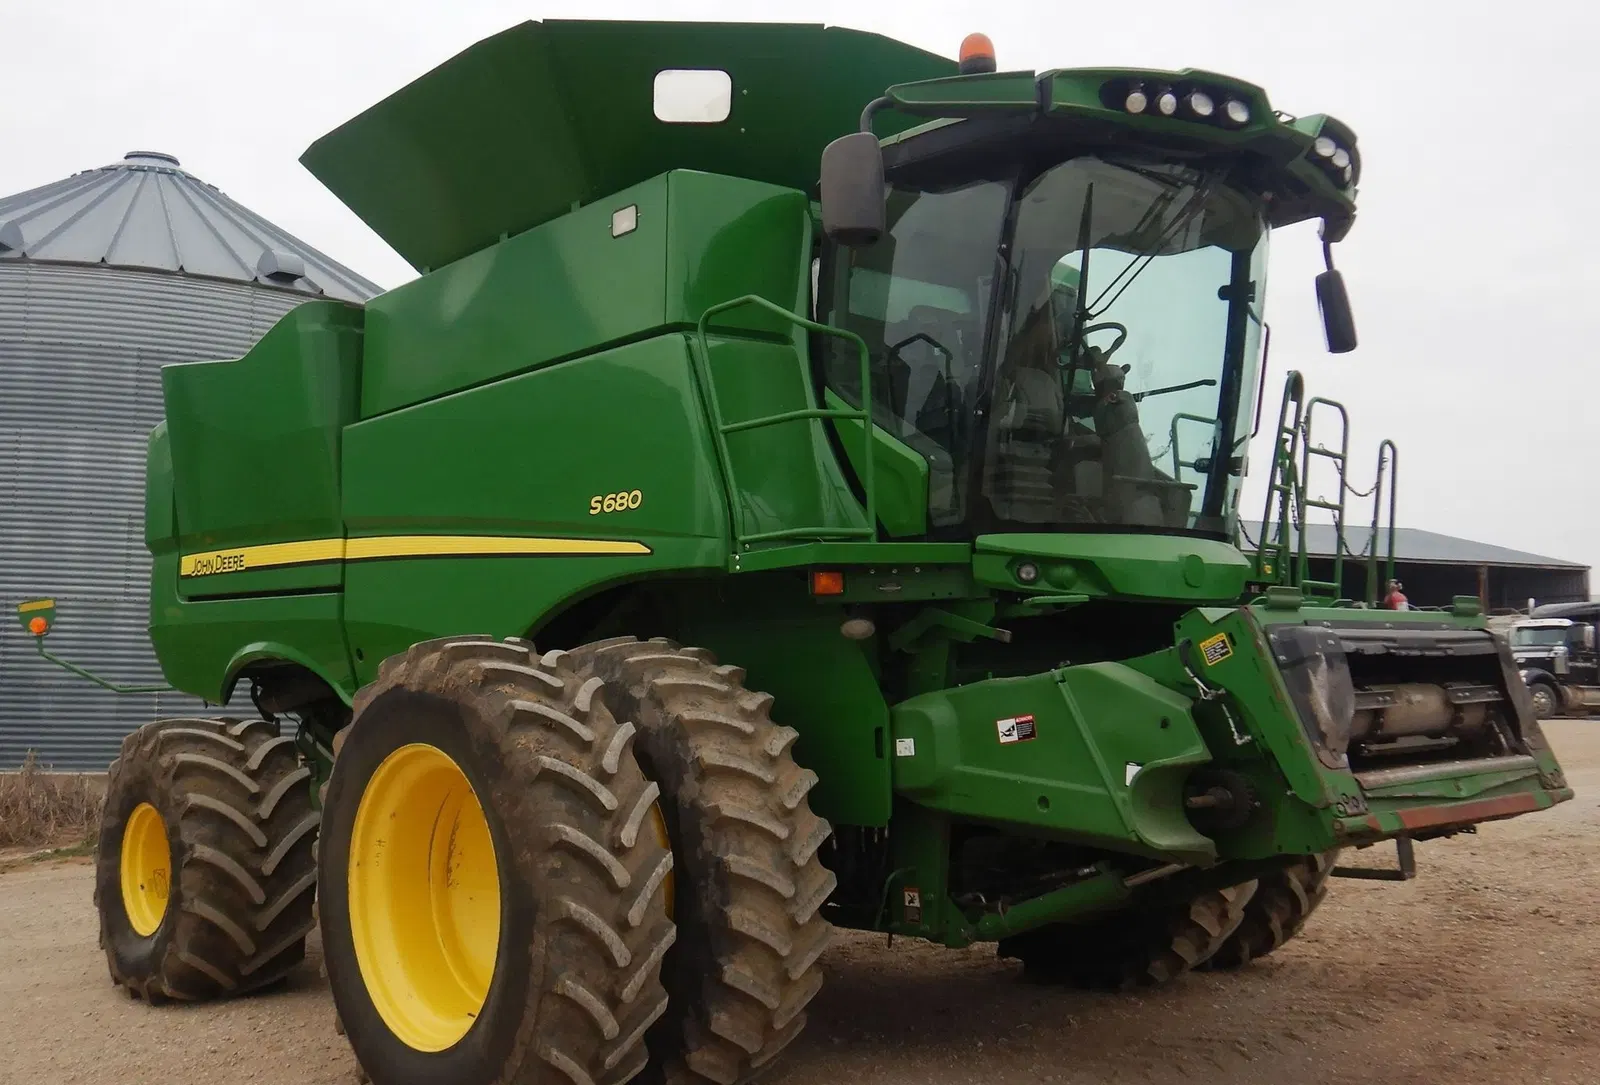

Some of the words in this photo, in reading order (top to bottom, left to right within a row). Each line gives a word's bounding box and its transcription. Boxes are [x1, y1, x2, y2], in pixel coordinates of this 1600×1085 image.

[589, 489, 643, 515] S680
[191, 558, 215, 576] JOHN
[216, 554, 246, 573] DEERE
